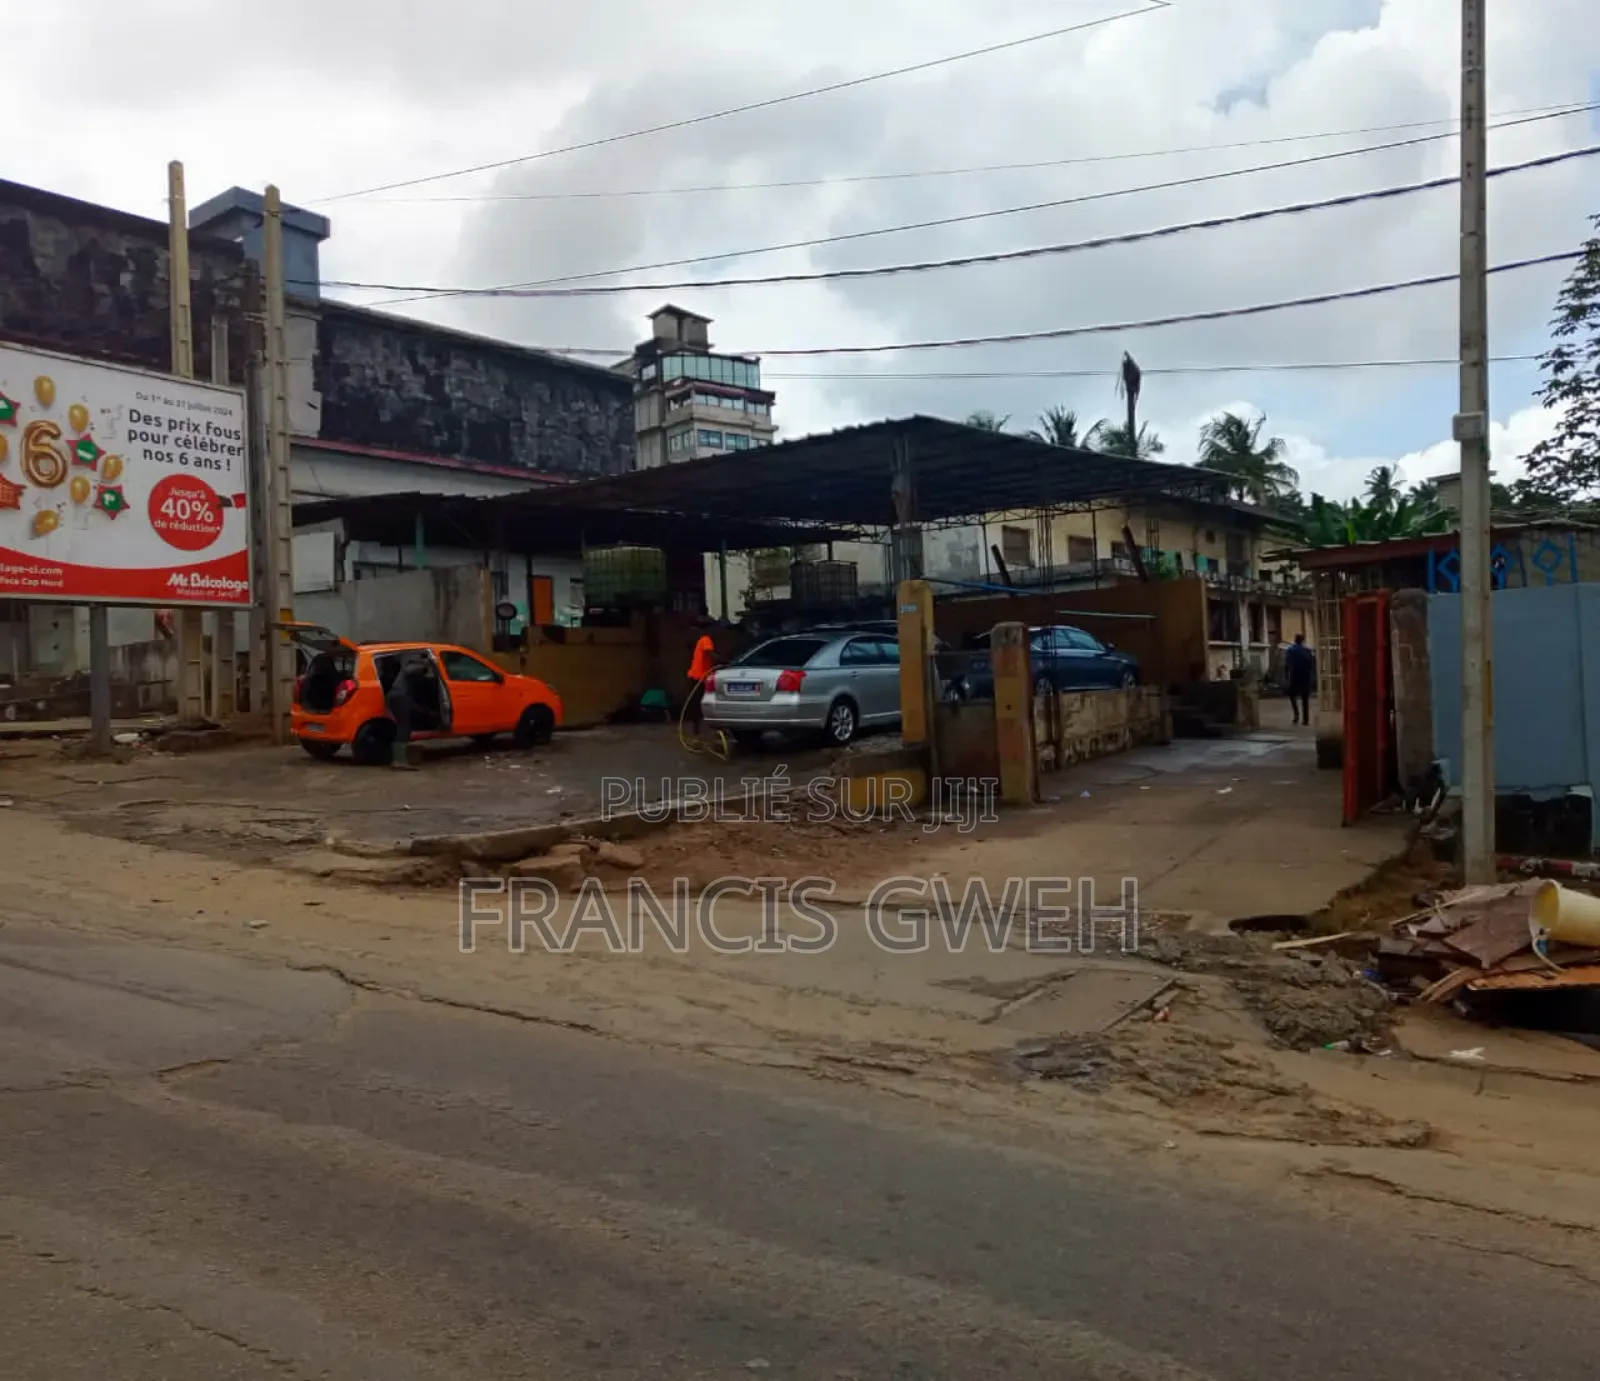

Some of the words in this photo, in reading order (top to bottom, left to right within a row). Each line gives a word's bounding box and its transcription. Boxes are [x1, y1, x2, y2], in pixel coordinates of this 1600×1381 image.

[129, 408, 162, 428] Des
[168, 418, 201, 434] prix
[206, 420, 241, 441] fous
[128, 429, 169, 446] pour
[174, 434, 244, 457] célébrer
[143, 448, 174, 463] nos
[179, 452, 189, 466] 6
[194, 456, 222, 471] ans
[161, 498, 214, 523] 40%
[154, 519, 167, 528] de
